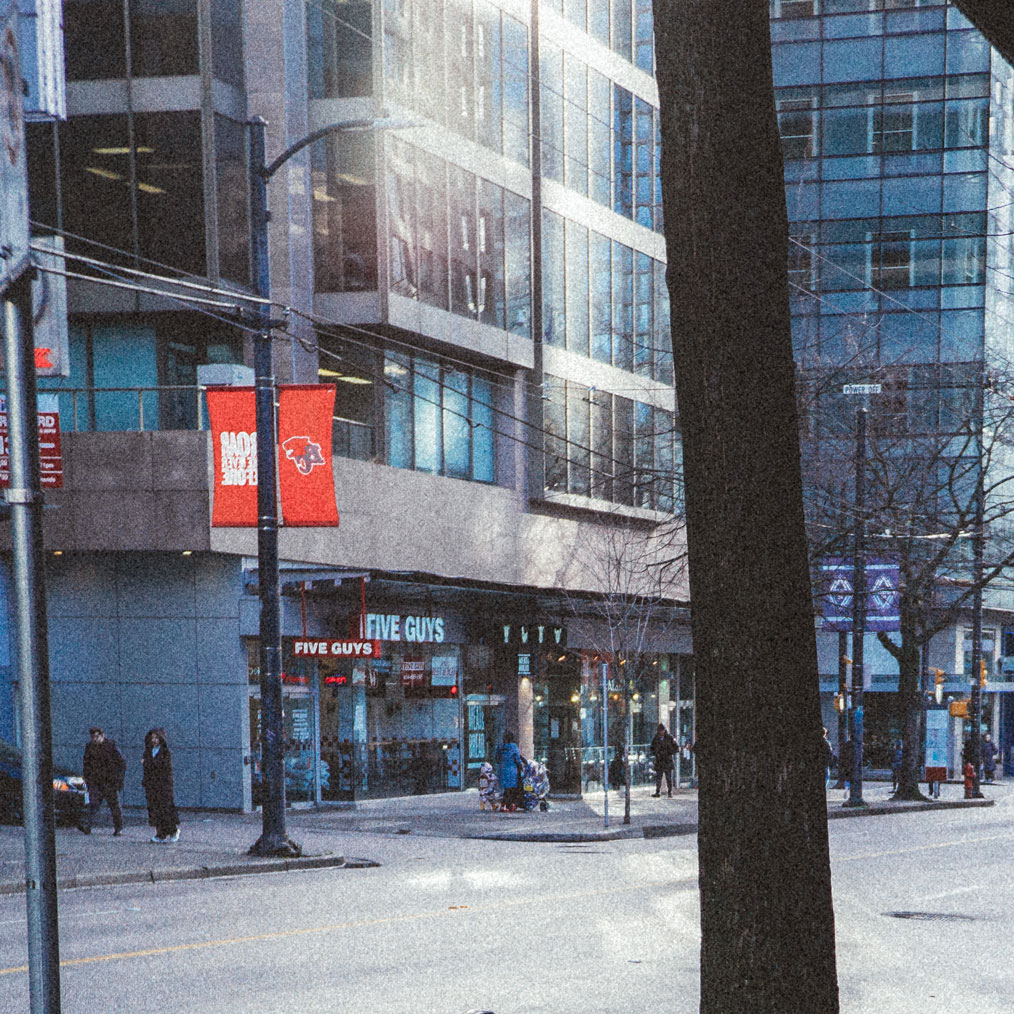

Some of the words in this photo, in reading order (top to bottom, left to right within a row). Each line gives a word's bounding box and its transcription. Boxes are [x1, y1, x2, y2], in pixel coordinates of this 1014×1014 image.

[366, 613, 400, 641] FIVE
[404, 615, 445, 643] GUYS
[294, 641, 328, 654] FIVE
[331, 641, 373, 654] GUYS
